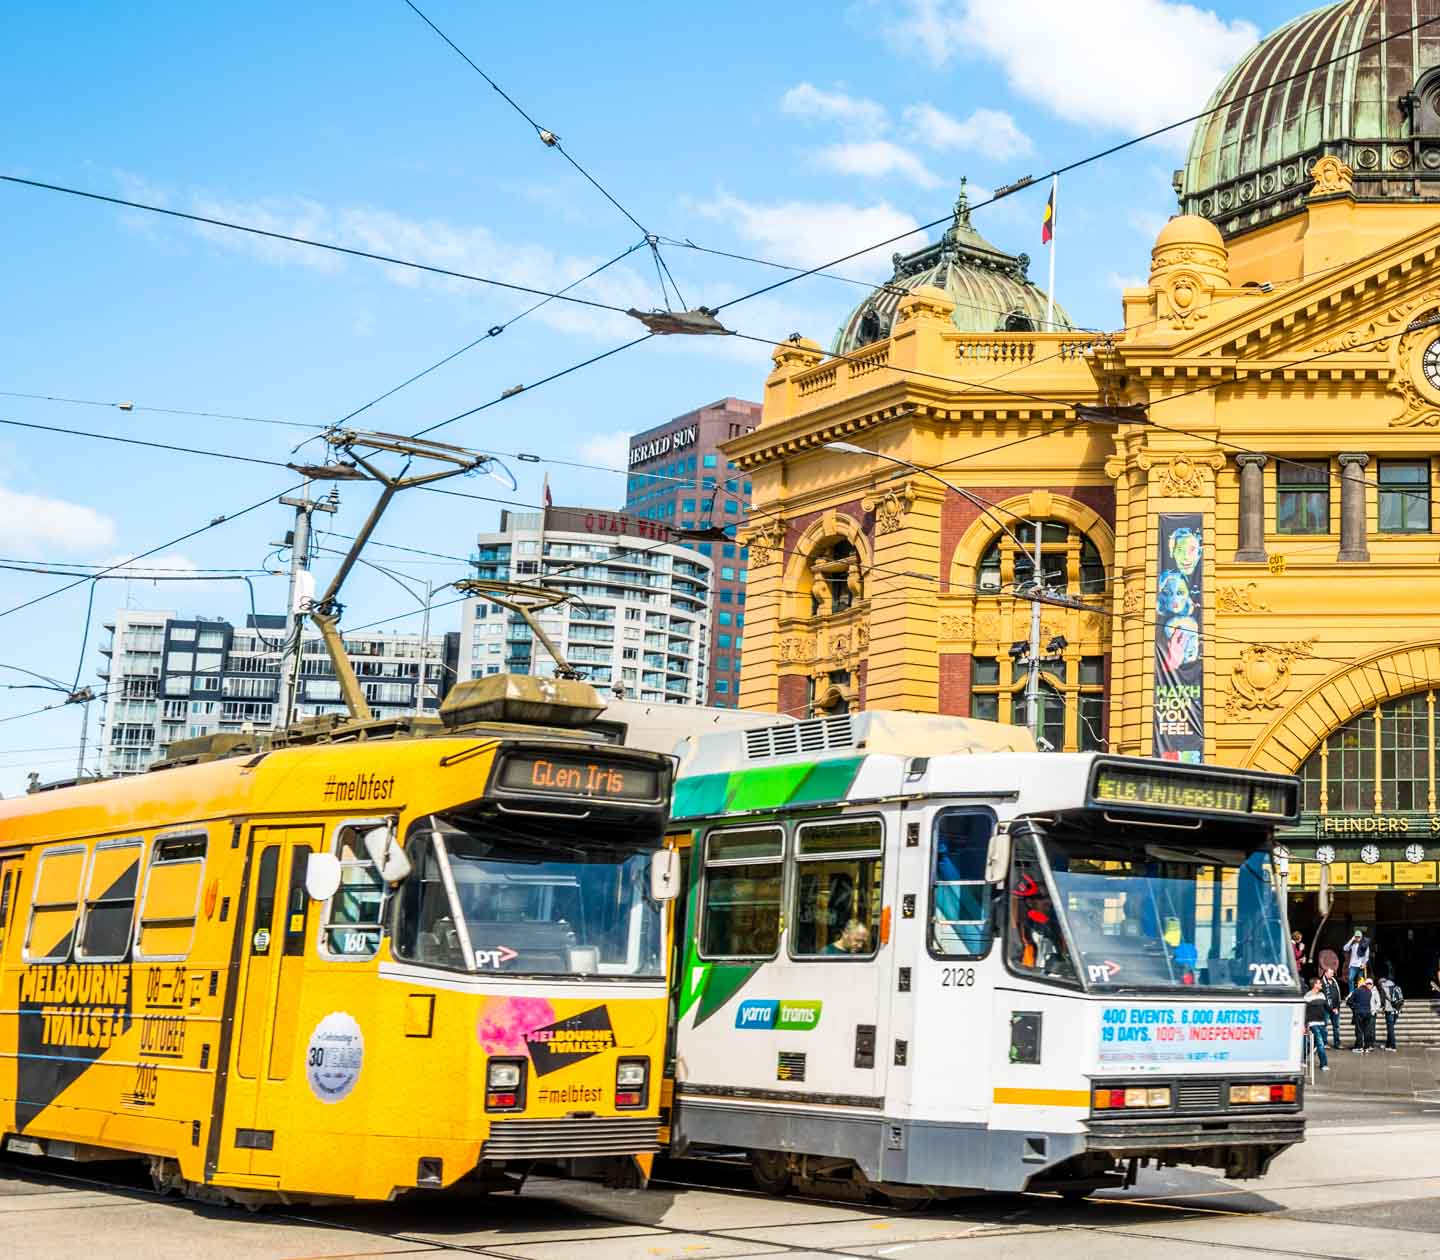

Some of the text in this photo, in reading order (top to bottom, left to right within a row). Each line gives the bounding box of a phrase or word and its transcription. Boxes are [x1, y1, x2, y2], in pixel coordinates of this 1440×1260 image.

[629, 436, 670, 465] HERALD
[673, 424, 697, 449] SUN
[1156, 709, 1189, 723] YOU
[1159, 722, 1194, 736] FEEL
[323, 774, 395, 802] #melbfest
[586, 764, 625, 793] Iris
[1323, 816, 1410, 832] FLINDERS
[343, 932, 367, 952] 160
[20, 963, 131, 1005] MELBOURNE
[942, 967, 976, 988] 2128
[1249, 964, 1291, 986] 2128
[741, 1006, 816, 1025] yarra trams
[1103, 1008, 1127, 1025] 400
[1130, 1008, 1177, 1025] EVENTS.
[1215, 1009, 1262, 1025] ARTISTS.
[41, 1005, 132, 1049] FESTIVAL
[525, 1029, 614, 1043] MELBOURNE
[1101, 1026, 1115, 1042] 19
[1117, 1026, 1152, 1042] DAYS.
[309, 1047, 324, 1067] 30
[537, 1085, 604, 1103] #melbfest
